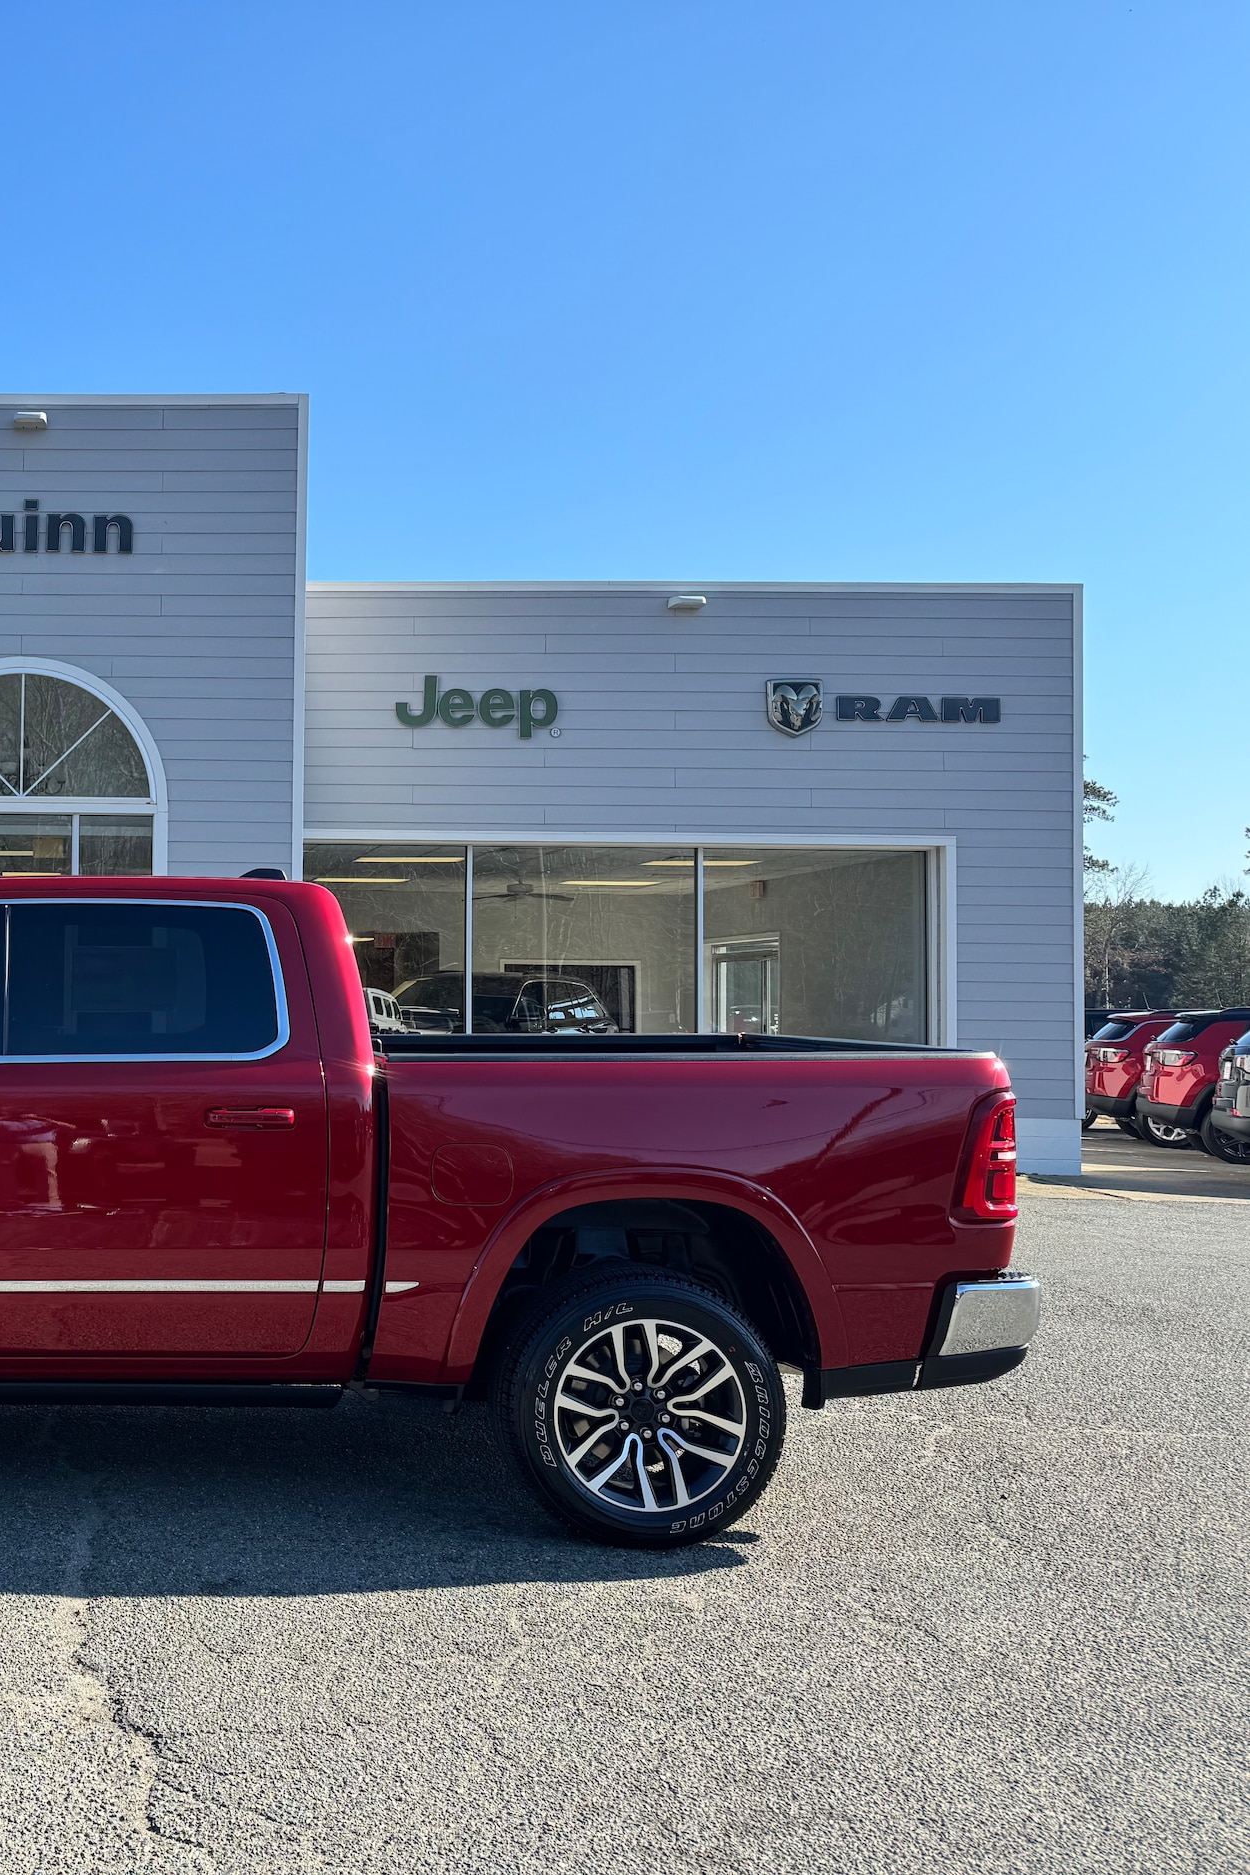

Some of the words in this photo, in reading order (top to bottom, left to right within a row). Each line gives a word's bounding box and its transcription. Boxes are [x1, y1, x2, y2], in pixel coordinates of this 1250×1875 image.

[395, 675, 558, 740] Jeep
[836, 695, 1001, 723] RAM
[535, 1336, 572, 1467] DUELER
[583, 1302, 633, 1331] H/L
[670, 1361, 771, 1534] BRIDGESTONE
